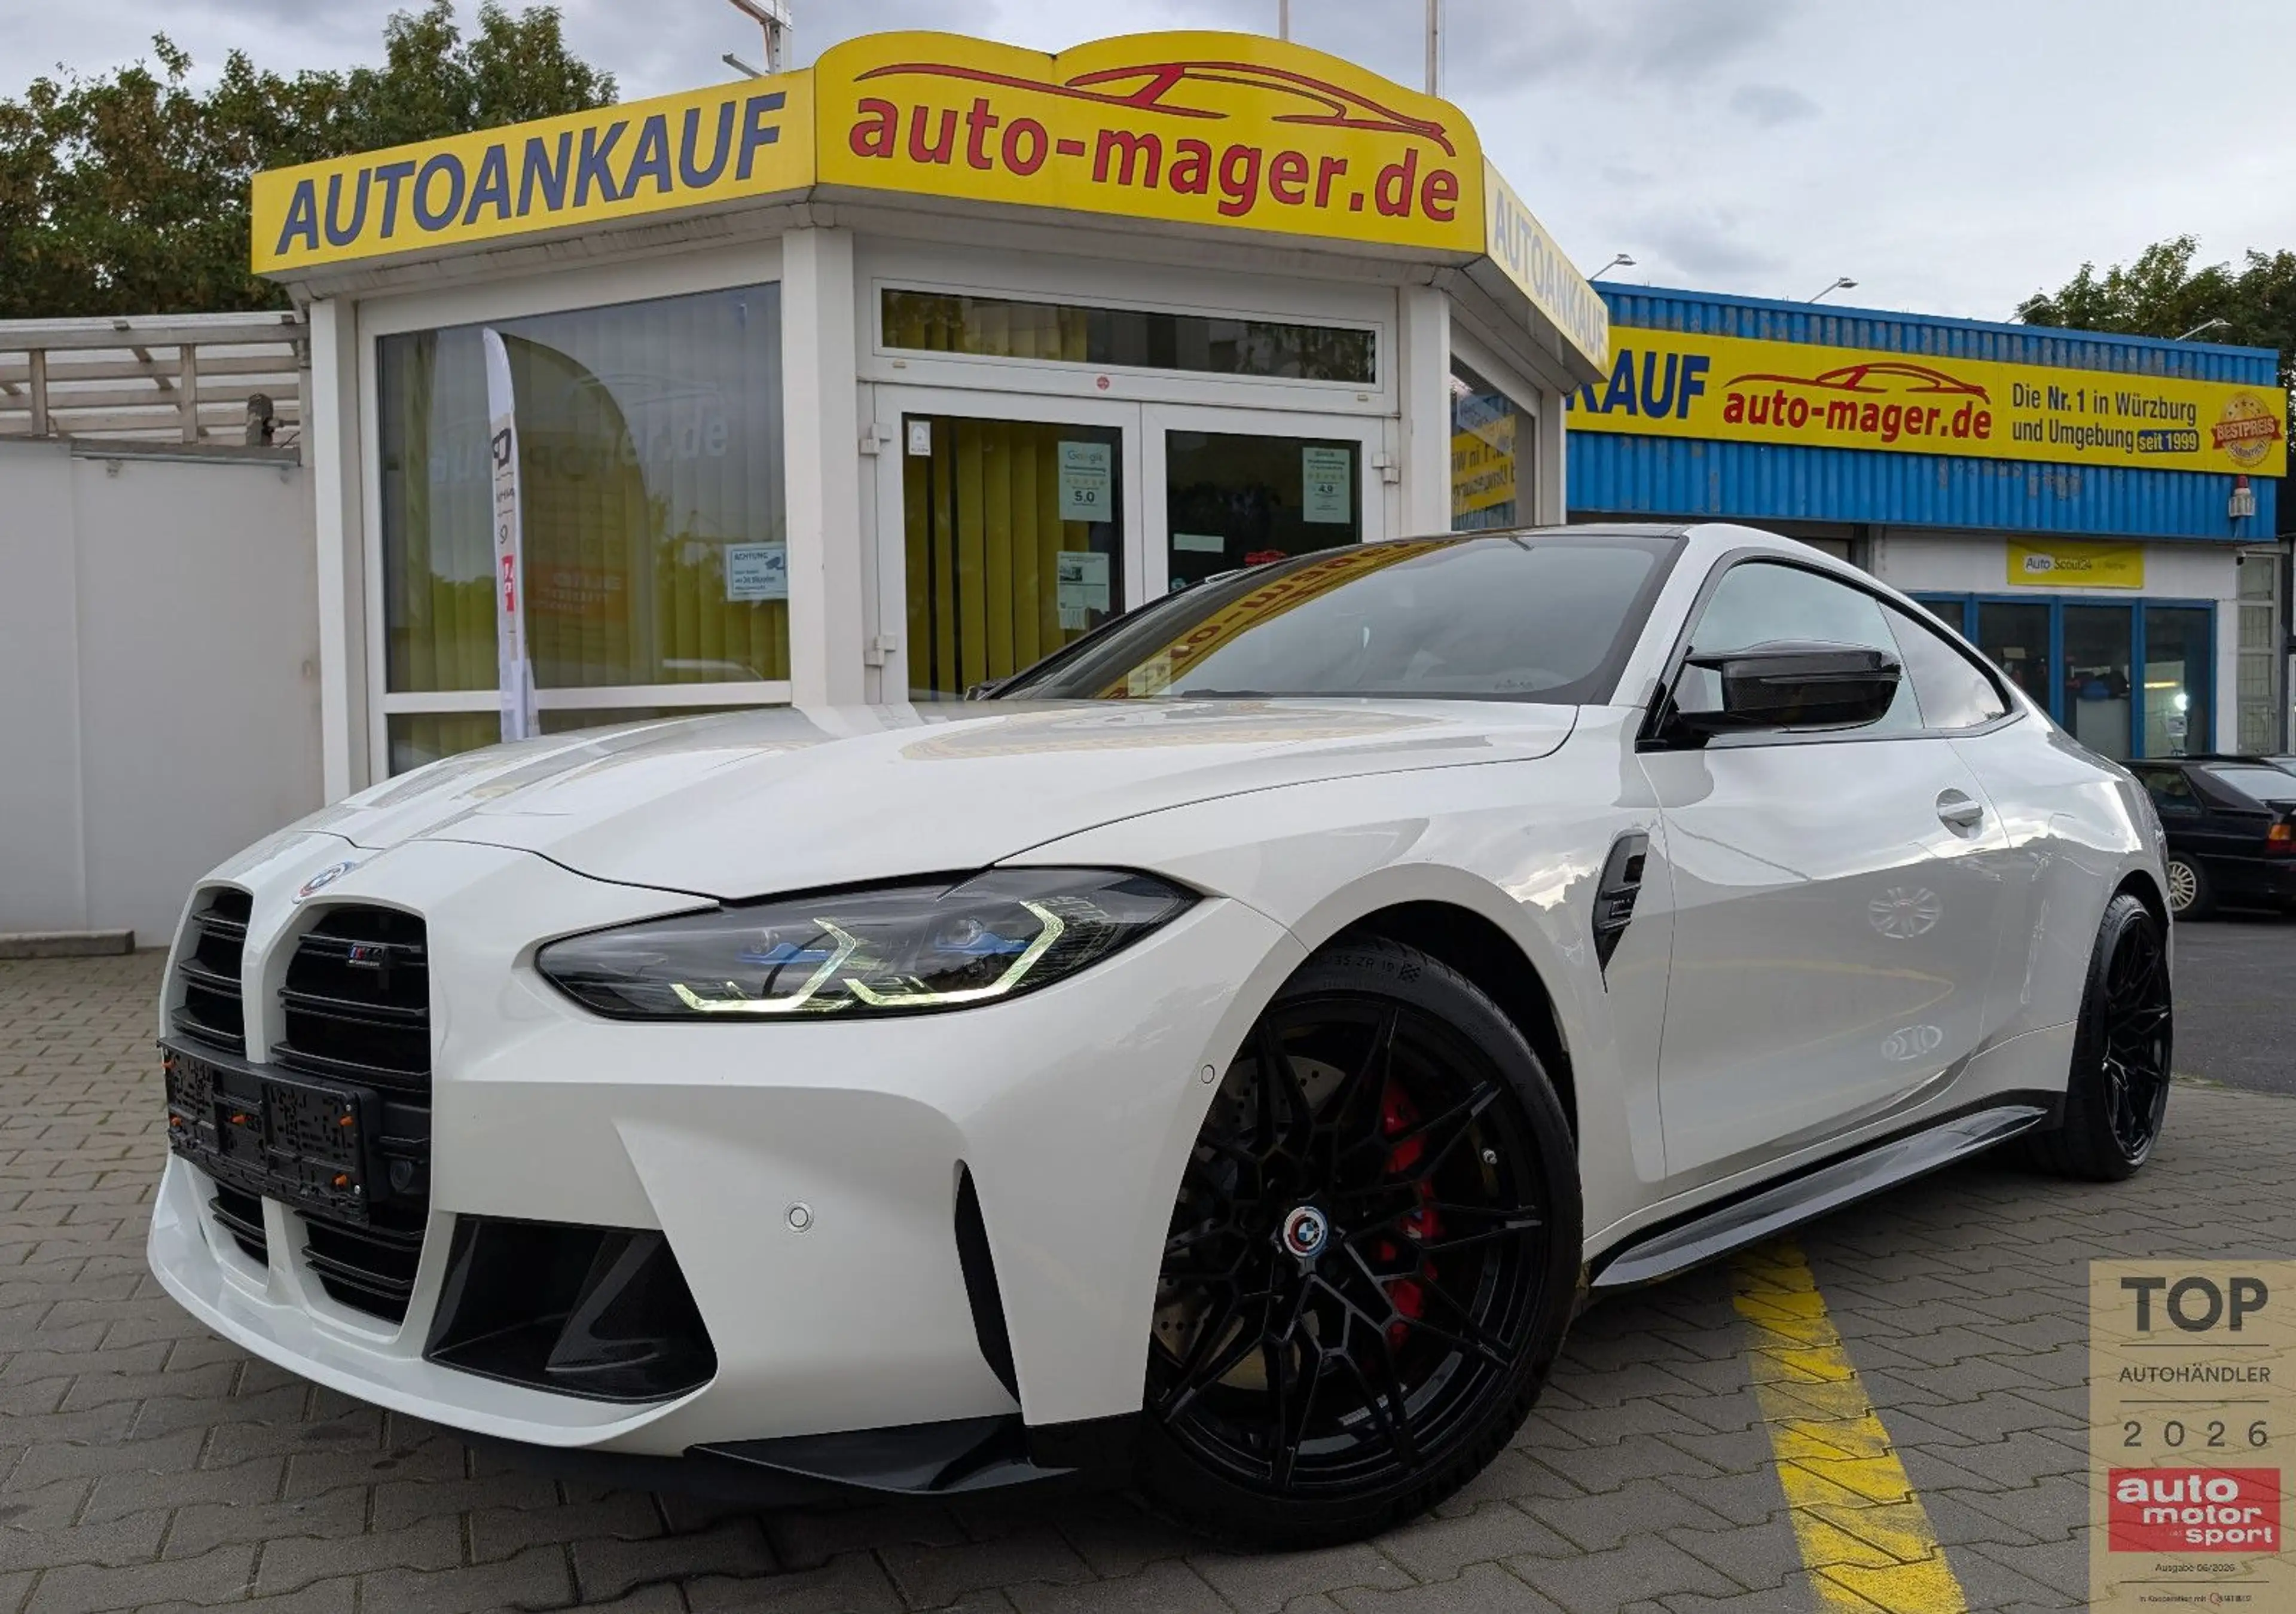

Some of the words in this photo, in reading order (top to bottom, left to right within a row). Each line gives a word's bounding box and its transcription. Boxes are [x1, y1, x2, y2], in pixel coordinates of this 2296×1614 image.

[275, 91, 786, 256] AUTOANKAUF
[849, 97, 1460, 222] auto-mager.de
[1495, 187, 1605, 358] AUTOANKAUF
[1723, 389, 1992, 443] auto-mager.de
[2012, 383, 2040, 409] Die
[2047, 386, 2071, 411] Nr.
[2076, 388, 2085, 412] 1
[2093, 390, 2109, 414] in
[2115, 392, 2197, 427] Würzburg
[2216, 418, 2276, 441] BESTPREIS
[2012, 418, 2042, 442] und
[2048, 419, 2133, 454] Umgebung
[2138, 433, 2163, 451] seit
[2166, 432, 2198, 451] 1999
[2026, 557, 2051, 570] Auto
